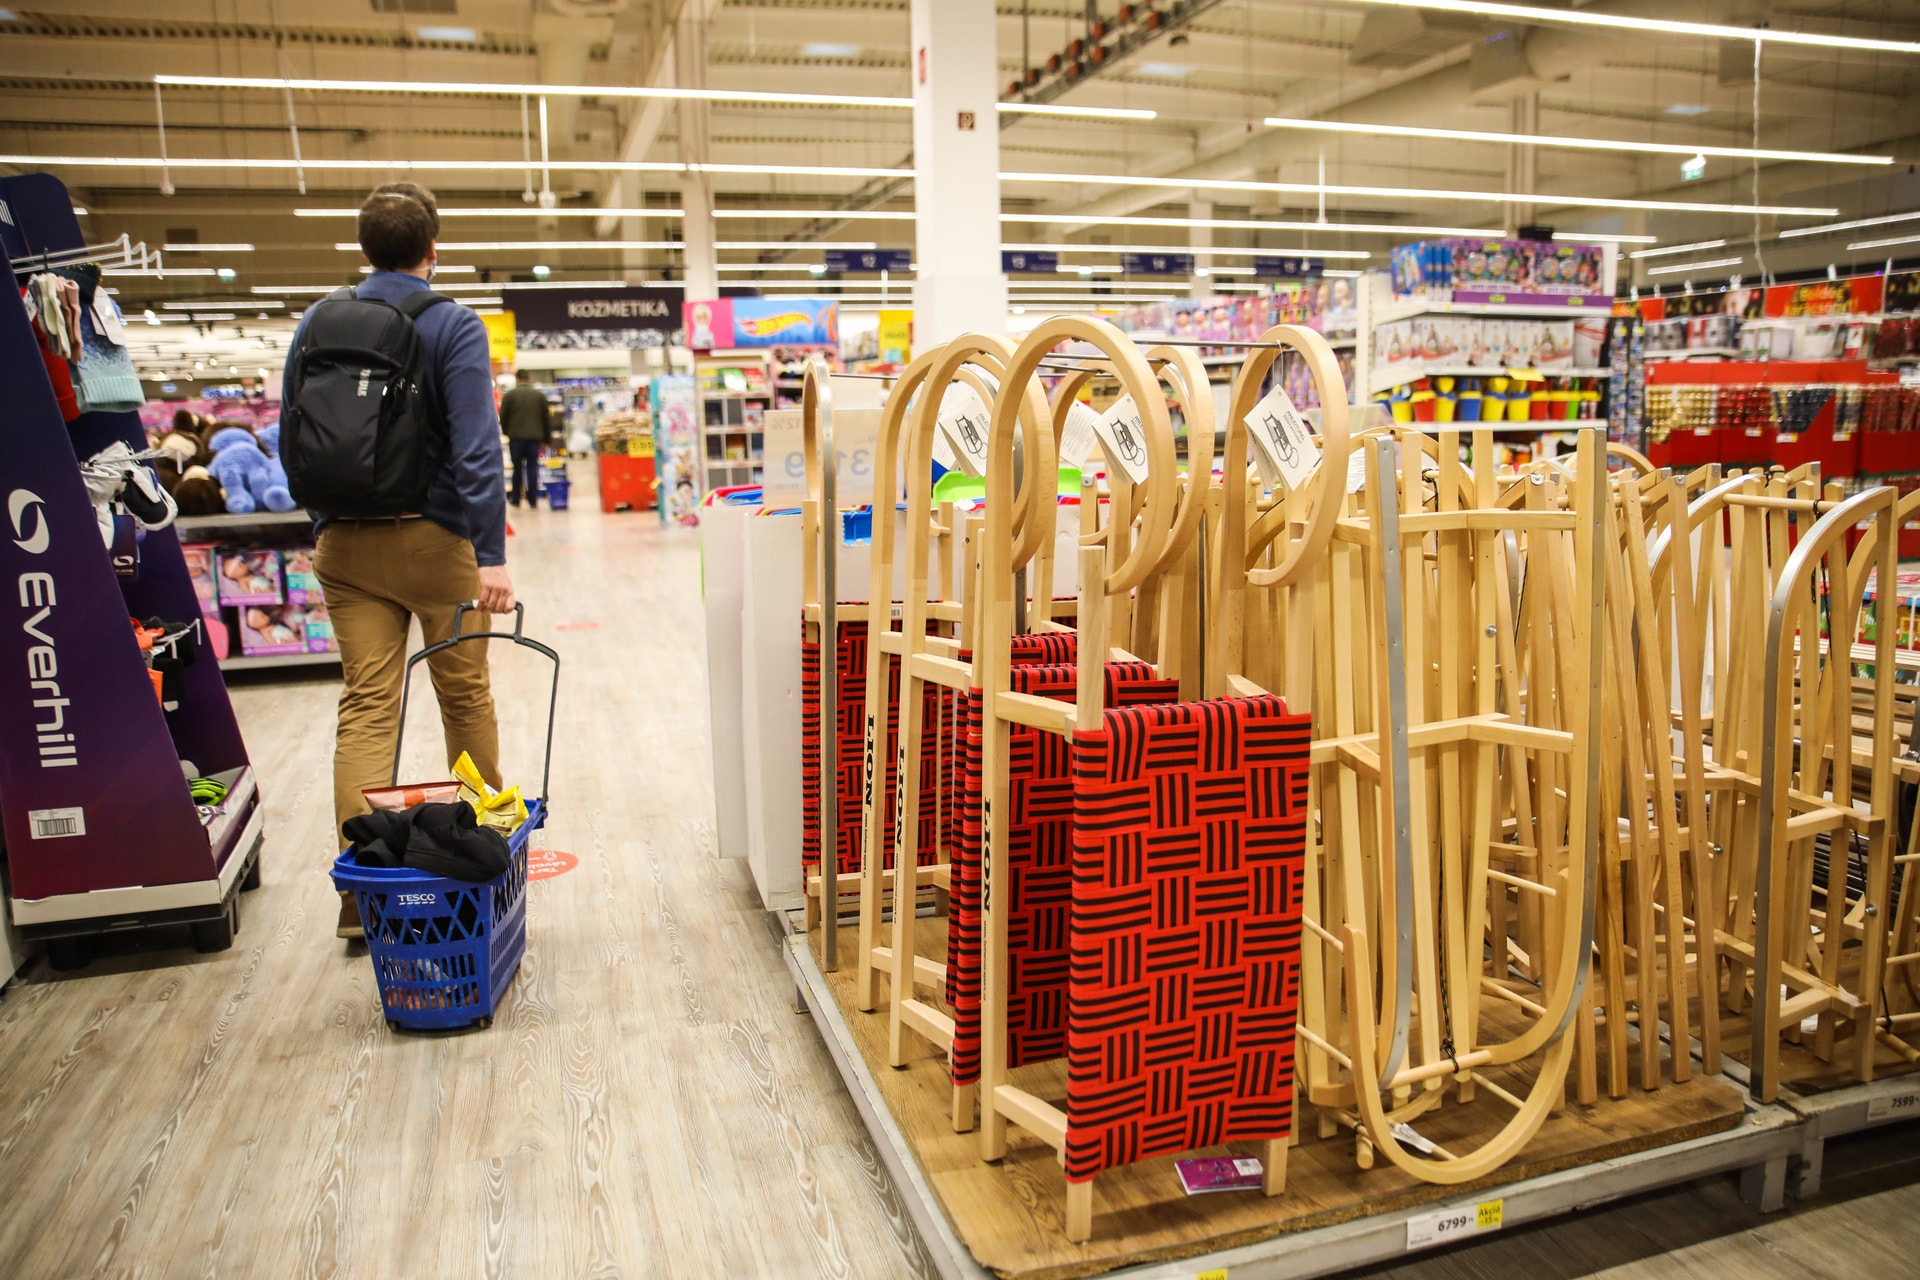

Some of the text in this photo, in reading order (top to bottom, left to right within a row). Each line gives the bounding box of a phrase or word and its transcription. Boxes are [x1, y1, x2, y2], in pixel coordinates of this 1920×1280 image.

[568, 299, 669, 318] KOZMETIKA
[866, 714, 875, 810] LION
[896, 745, 905, 850] LION
[983, 797, 991, 915] LION
[397, 893, 436, 902] TESCO
[1891, 1095, 1915, 1108] 7599
[1479, 1206, 1501, 1218] Akció
[1438, 1215, 1467, 1232] 6799
